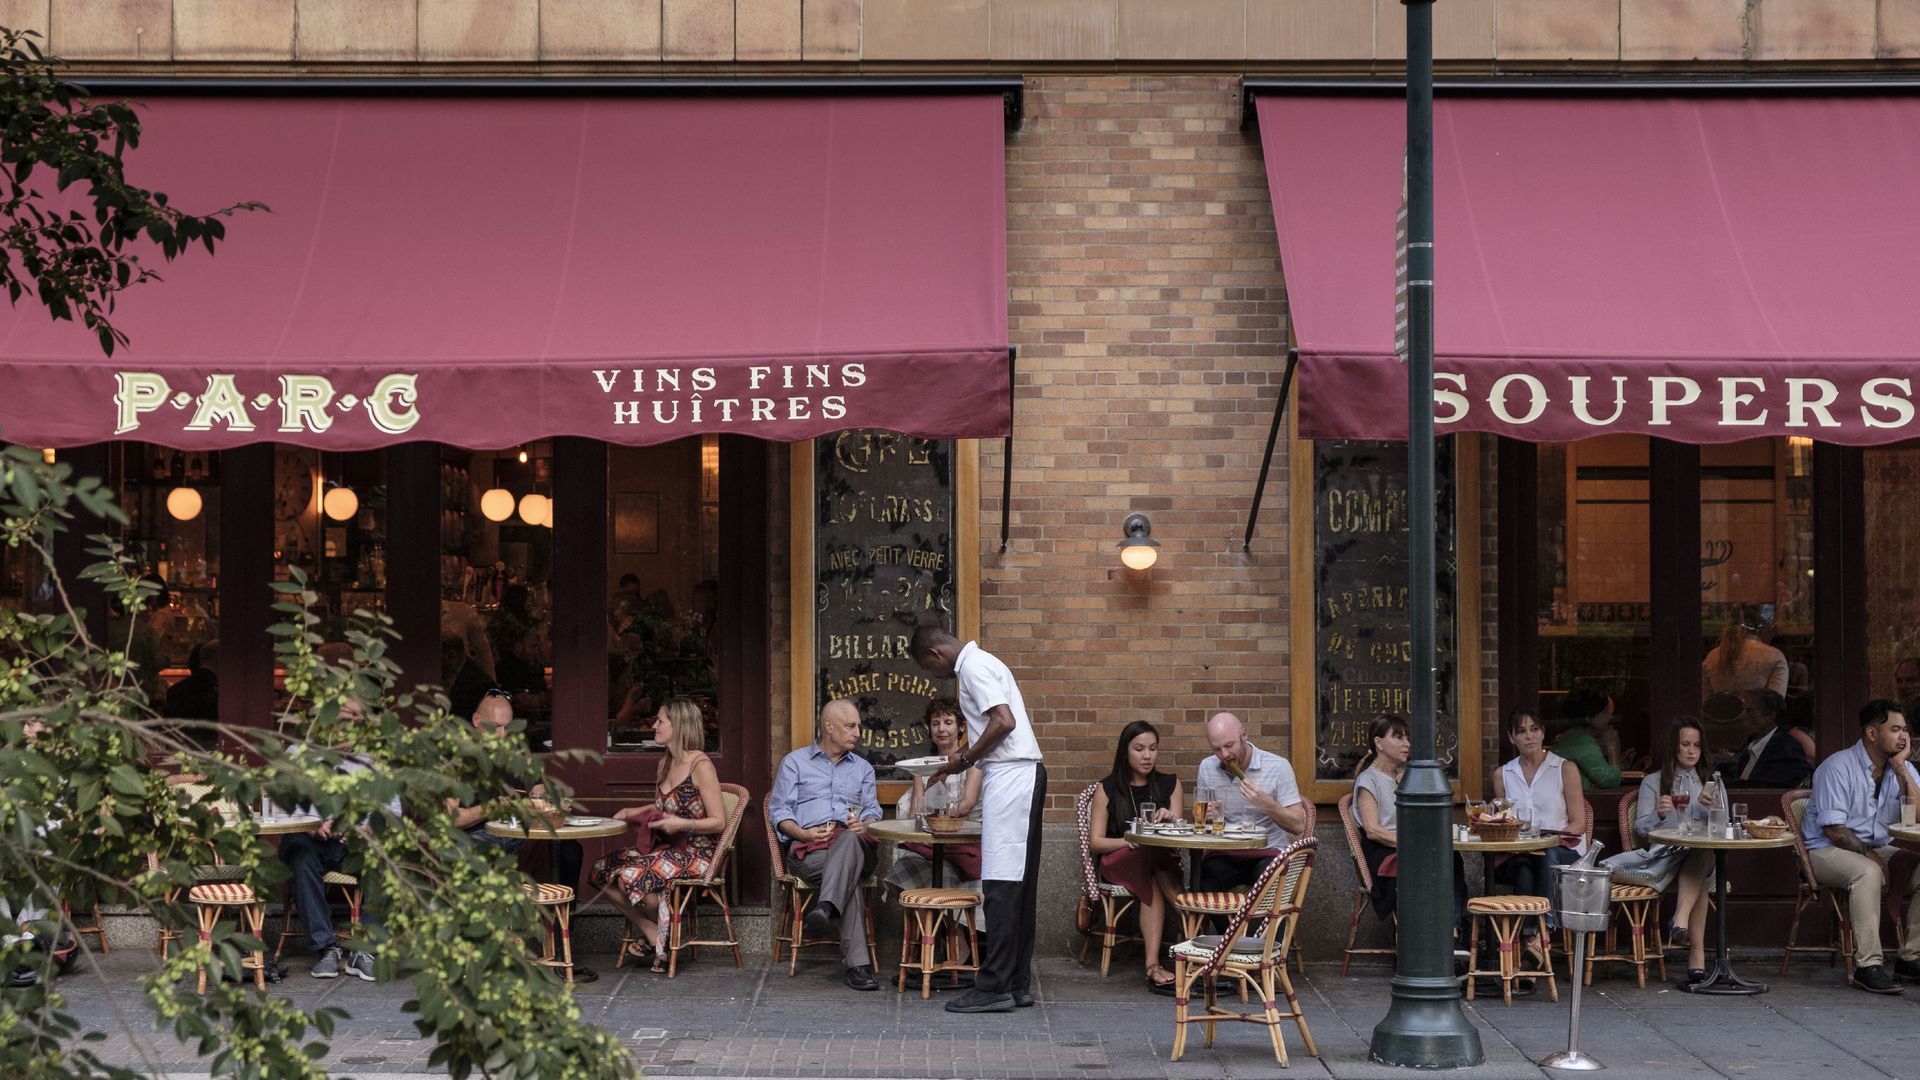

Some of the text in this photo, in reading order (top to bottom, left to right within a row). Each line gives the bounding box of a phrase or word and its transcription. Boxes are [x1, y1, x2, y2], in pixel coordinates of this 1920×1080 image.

[593, 363, 867, 393] VINS FINS
[613, 393, 847, 424] HUÎTRES
[1434, 373, 1915, 427] SOUPERS
[830, 545, 945, 571] AVEC PETIT VERRE
[829, 635, 910, 659] BILLAR
